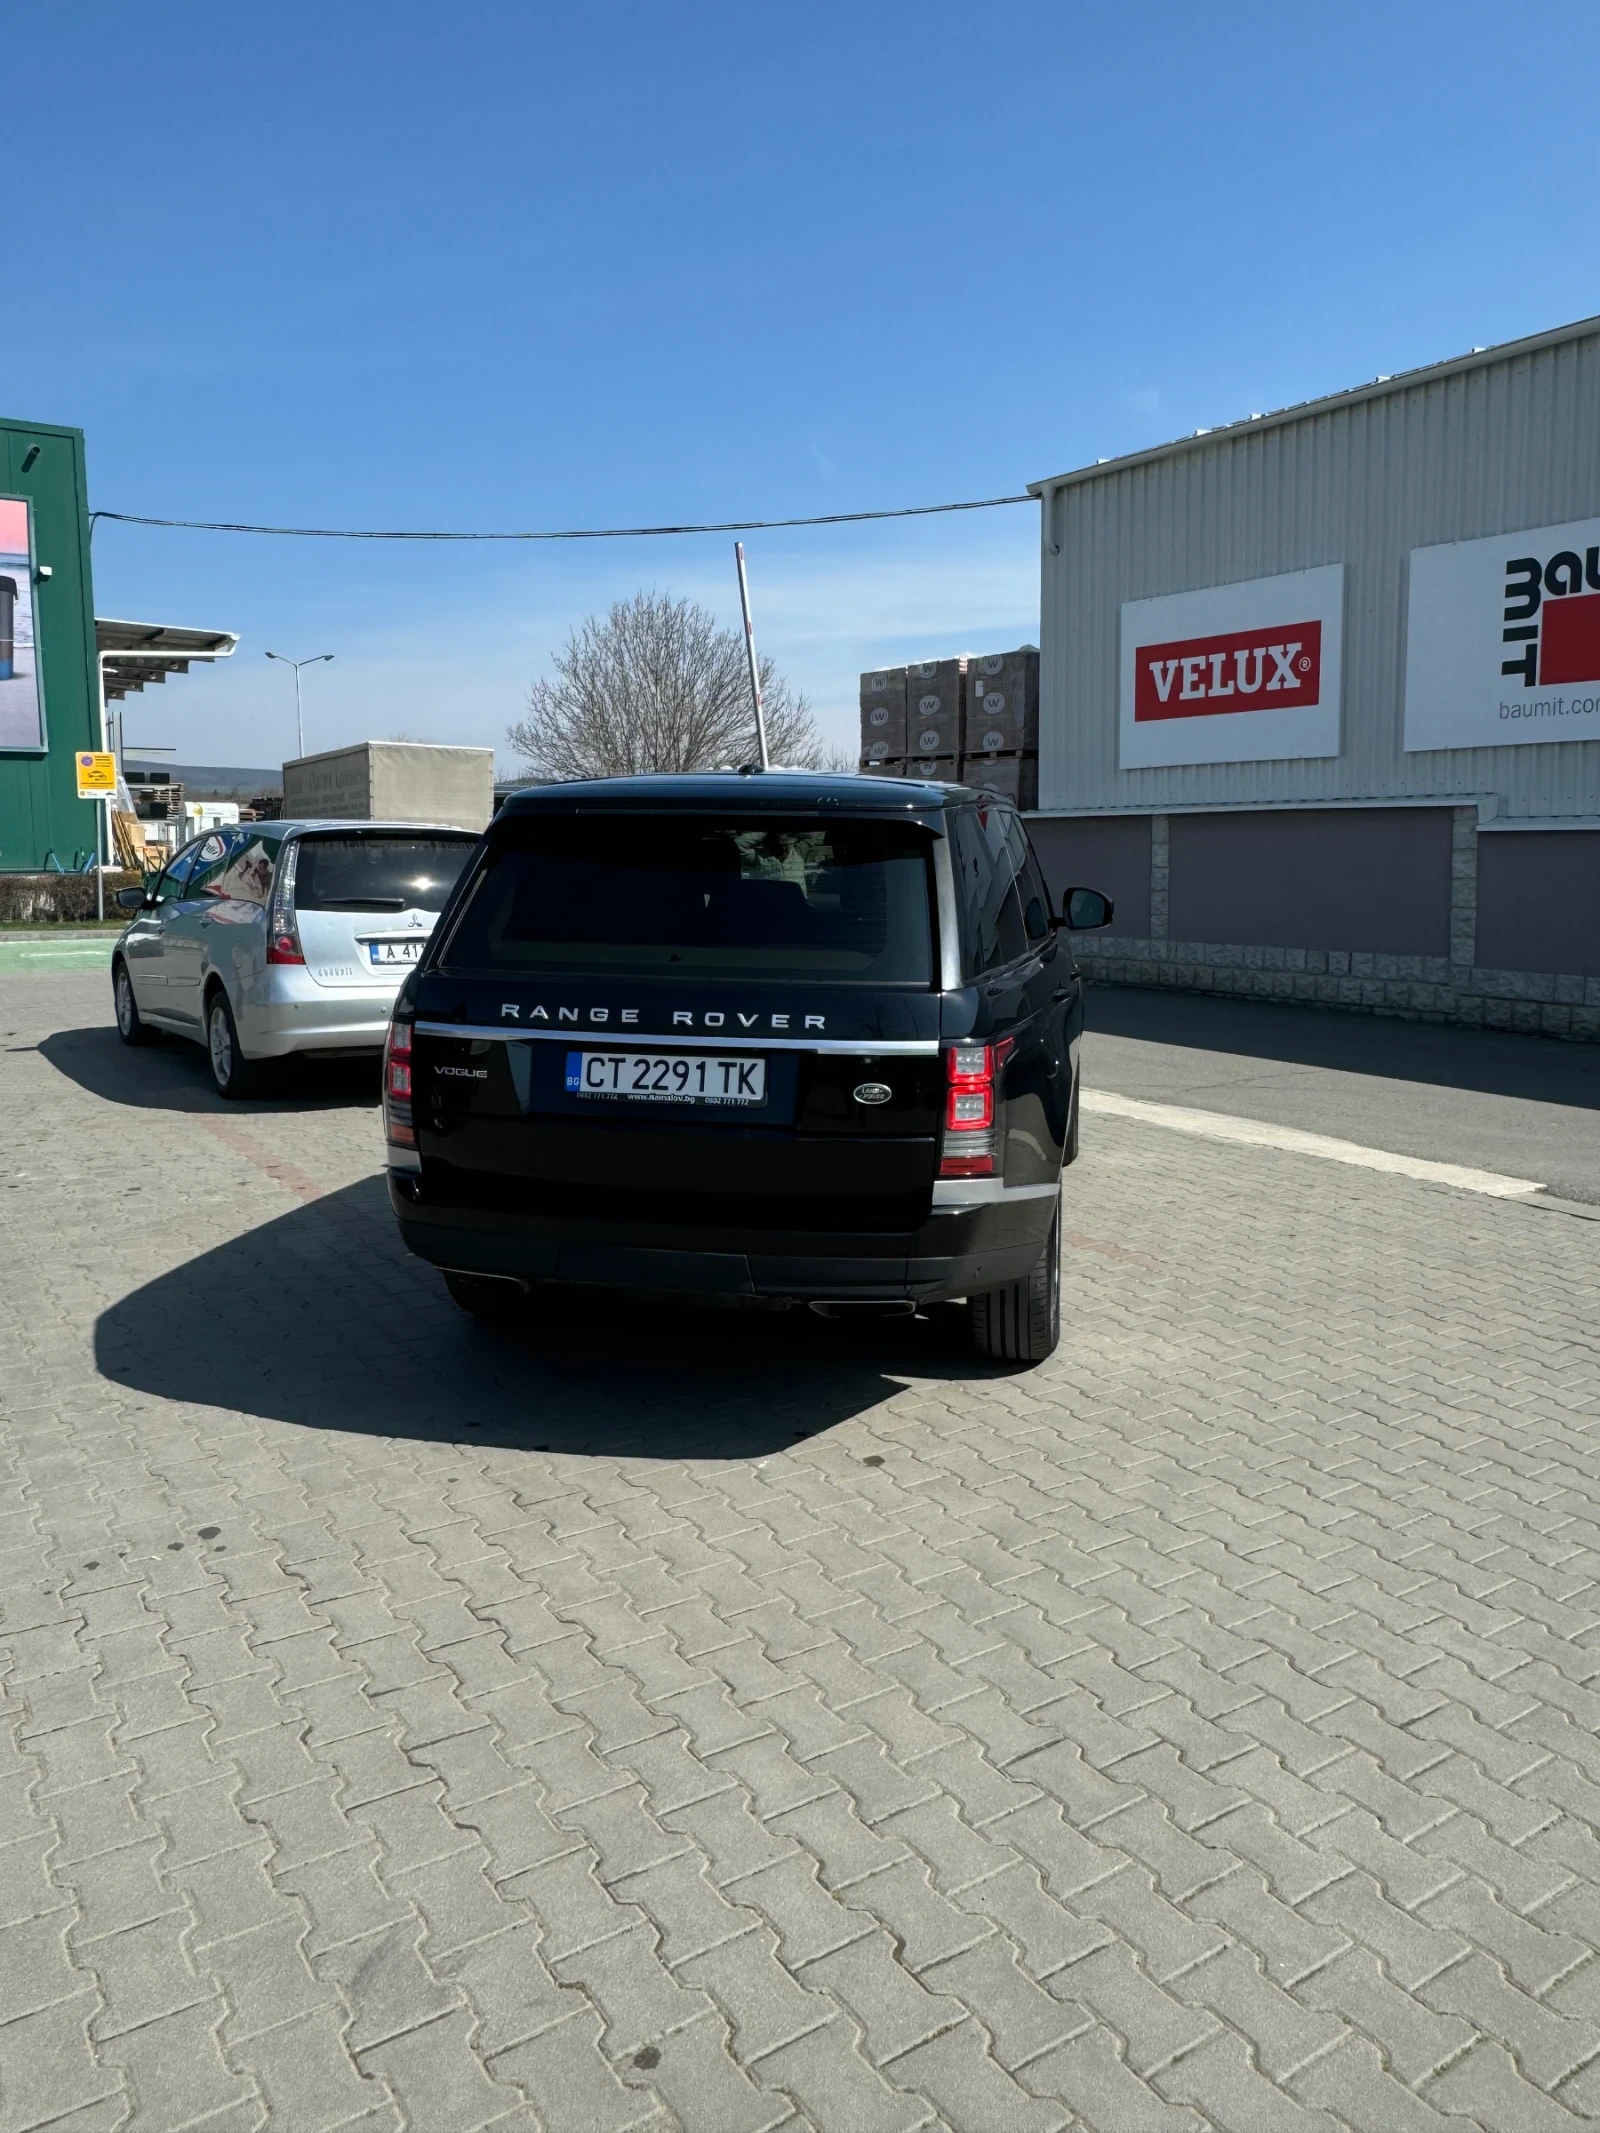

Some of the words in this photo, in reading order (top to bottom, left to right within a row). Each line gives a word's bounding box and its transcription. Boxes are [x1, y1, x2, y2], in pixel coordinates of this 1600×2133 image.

[387, 945, 396, 959] A
[501, 1003, 640, 1024] RANGE
[673, 1011, 826, 1030] ROVER
[433, 1065, 488, 1078] VOGUE
[586, 1056, 627, 1089] CT
[632, 1058, 707, 1092] 2291
[718, 1061, 758, 1095] TK
[566, 1076, 580, 1086] BG
